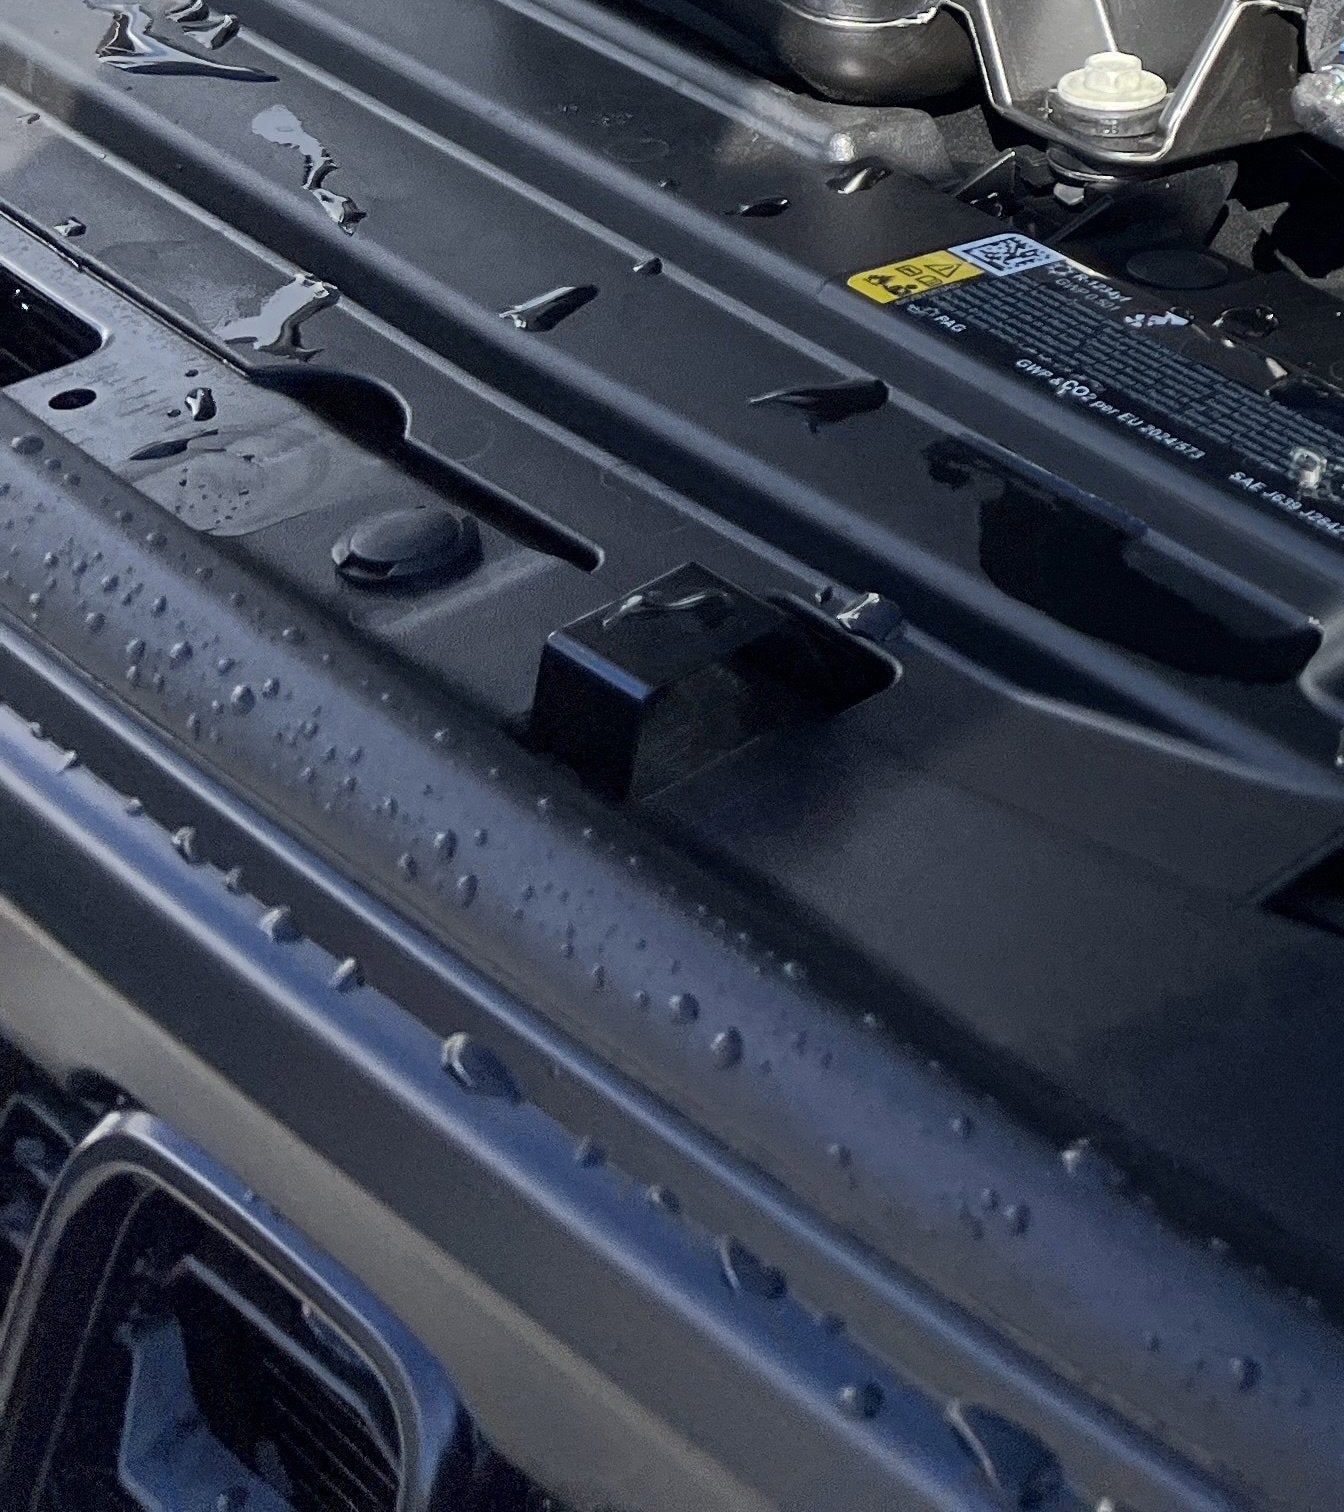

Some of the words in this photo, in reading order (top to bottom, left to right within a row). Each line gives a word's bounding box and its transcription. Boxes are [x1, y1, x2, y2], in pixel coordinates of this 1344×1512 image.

[934, 315, 967, 333] PAG
[1016, 359, 1054, 378] GWP
[1062, 379, 1097, 402] CO2
[1089, 400, 1120, 415] per
[1117, 412, 1144, 427] EU
[1228, 471, 1267, 493] SAE
[1262, 491, 1302, 512] J639
